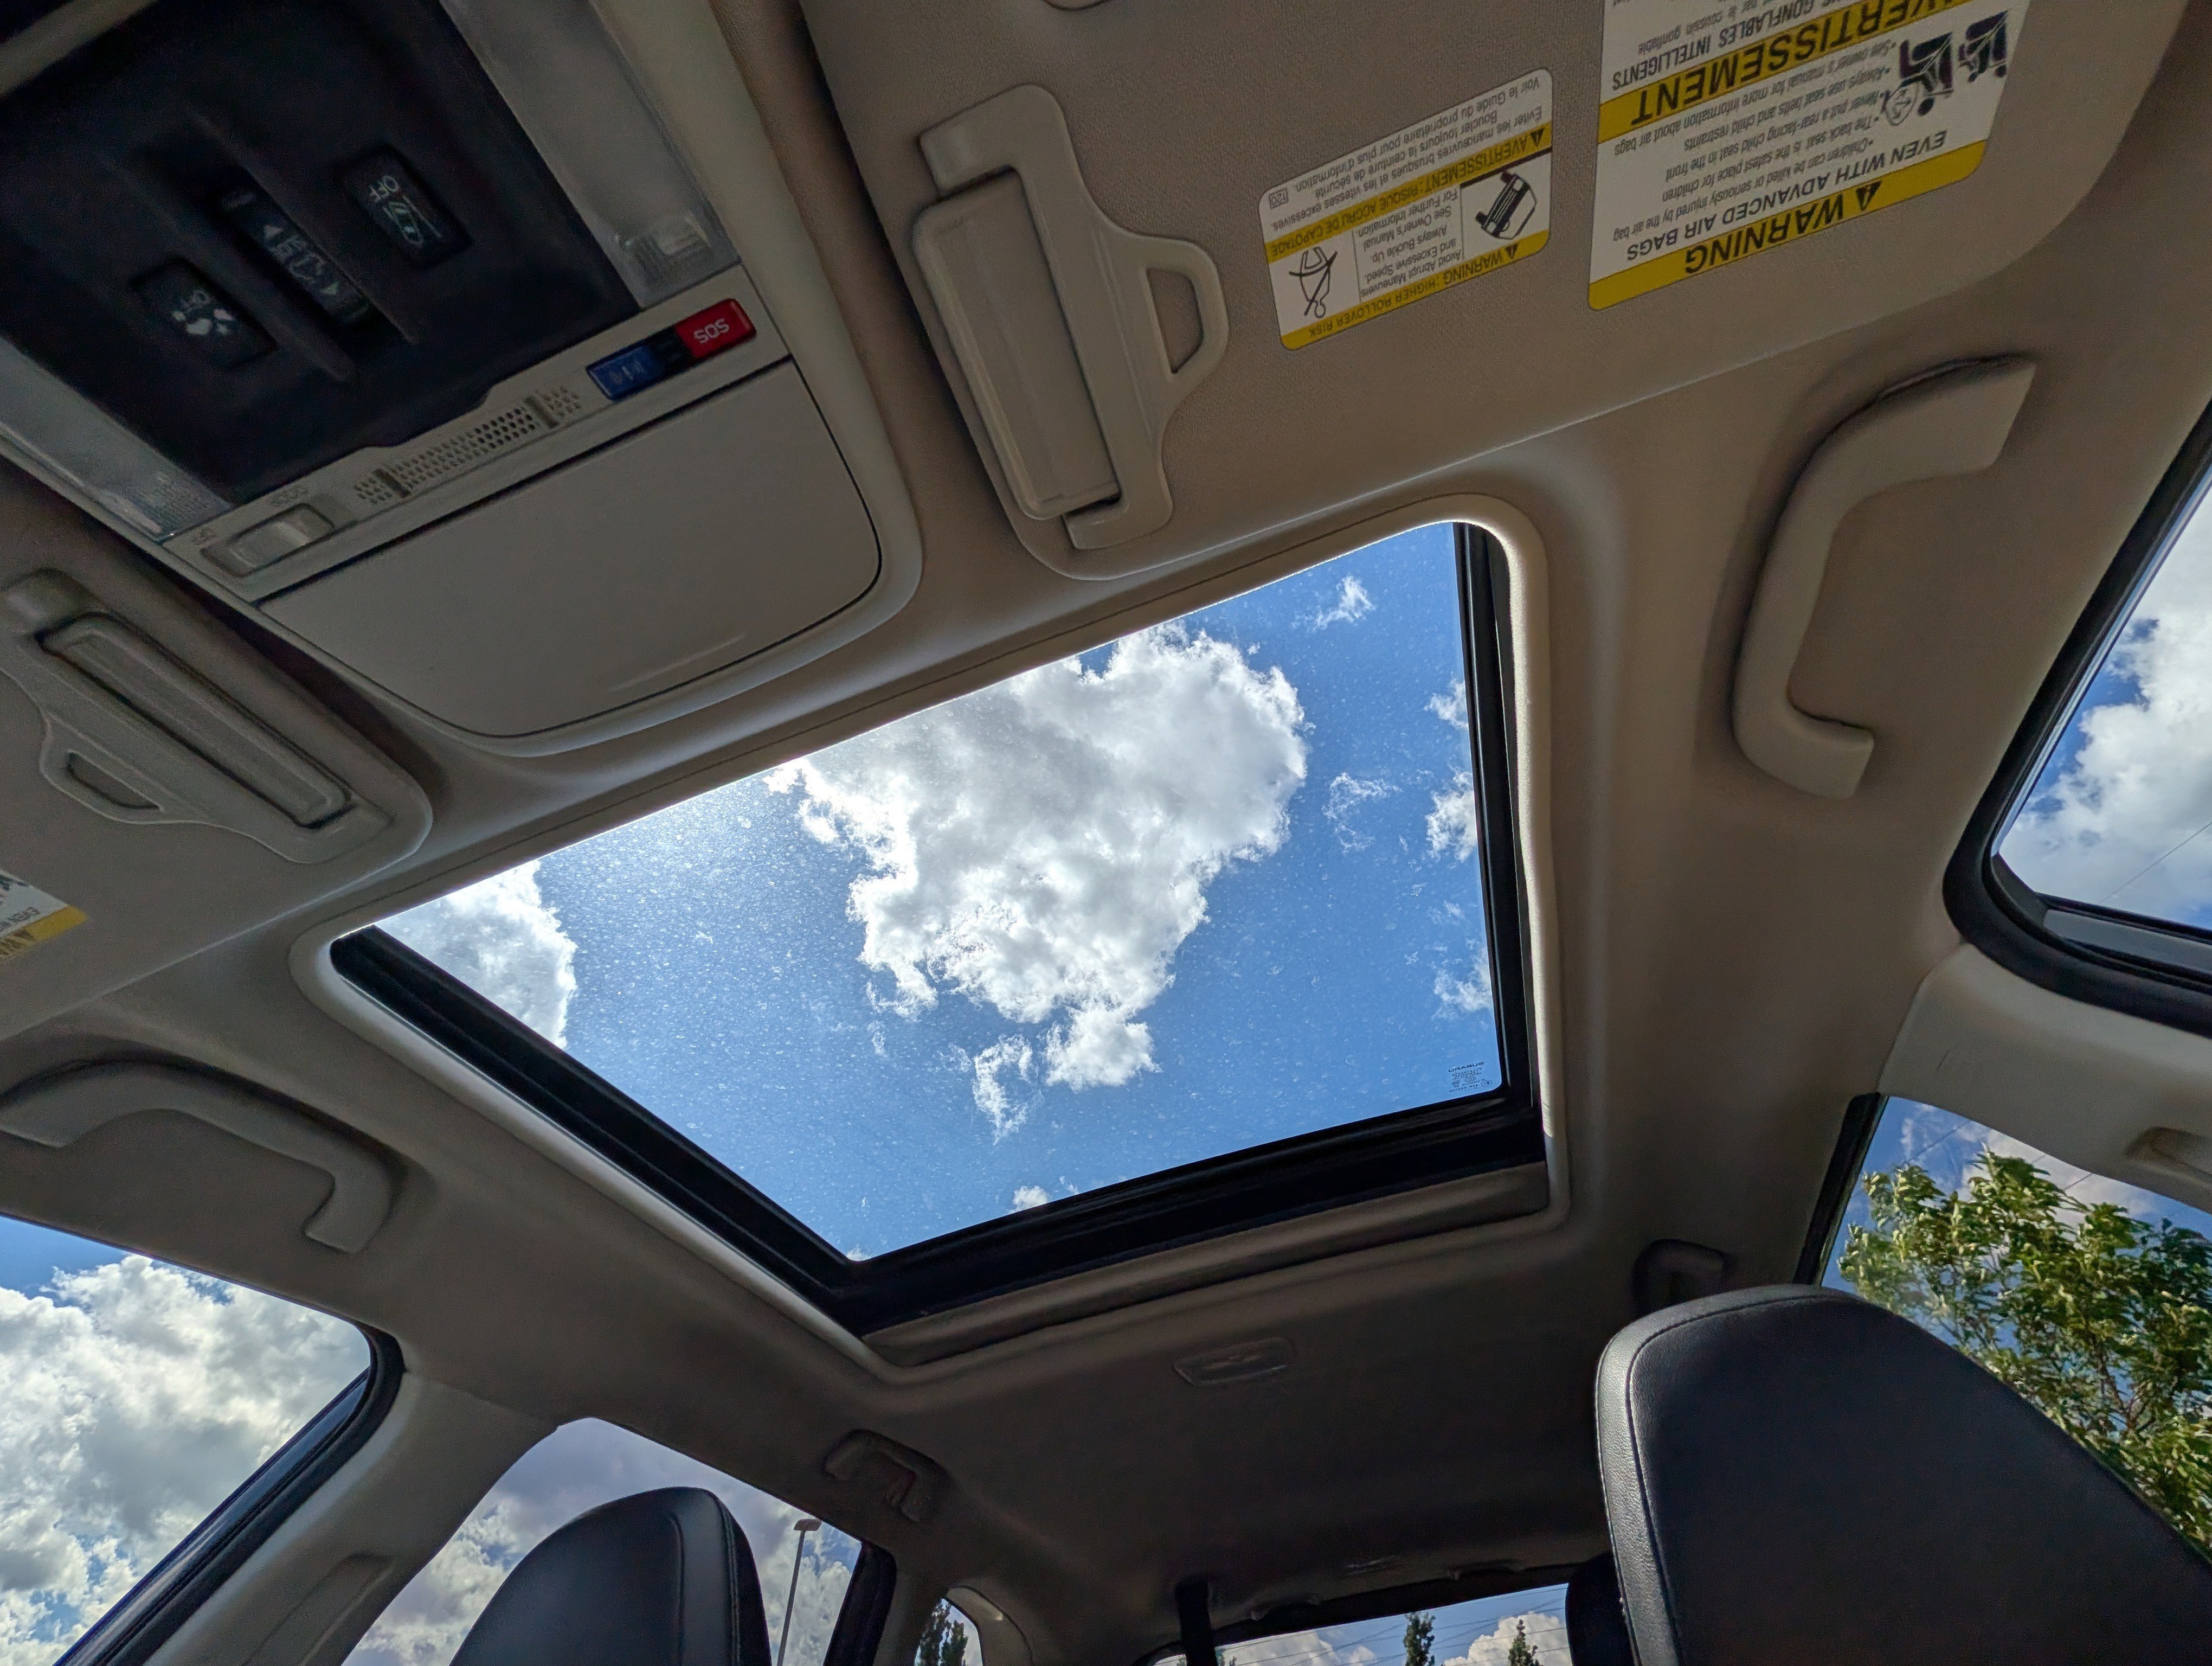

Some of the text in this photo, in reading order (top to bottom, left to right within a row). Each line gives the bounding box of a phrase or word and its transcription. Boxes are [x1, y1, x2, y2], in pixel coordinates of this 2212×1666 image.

[1612, 35, 1711, 91] INTELLIGENTS
[1631, 0, 1950, 125] ERTISSEMENT
[1508, 85, 1517, 102] le
[1520, 75, 1539, 97] Voir
[1741, 86, 1768, 106] more
[1461, 105, 1473, 122] du
[1476, 91, 1505, 116] Guide
[1682, 97, 1740, 131] information
[1461, 110, 1496, 138] Boucler
[1731, 114, 1755, 136] child
[1757, 106, 1777, 125] and
[1403, 108, 1458, 147] propriétaire
[1497, 119, 1510, 137] les
[1653, 120, 1681, 144] about
[1683, 124, 1729, 153] restraints
[1379, 134, 1400, 156] pour
[1419, 125, 1457, 154] toujours
[1613, 134, 1637, 158] bags
[1638, 131, 1651, 149] air
[1741, 132, 1765, 154] child
[1356, 146, 1377, 167] plus
[1408, 145, 1417, 159] la
[1707, 151, 1717, 166] in
[1719, 142, 1739, 161] seat
[1774, 144, 1791, 164] the
[1807, 152, 1826, 169] can
[1367, 150, 1405, 177] ceinture
[1391, 151, 1433, 182] brusques
[1665, 162, 1689, 183] front
[1690, 155, 1706, 172] the
[1716, 161, 1742, 185] place
[1742, 151, 1773, 175] safest
[1353, 168, 1365, 184] de
[1363, 178, 1377, 193] les
[1379, 173, 1388, 186] et
[1701, 172, 1715, 191] for
[1753, 176, 1764, 190] or
[1766, 165, 1791, 187] killed
[368, 174, 400, 203] OFF
[1270, 134, 1527, 258] AVERTISSEMENT RISQUE ACCRU DE CAPOTAGE
[1324, 185, 1361, 210] vitesses
[1442, 188, 1457, 205] For
[1626, 129, 1948, 262] EVEN WITH ADVANCED AIR BAGS
[1661, 178, 1700, 206] children
[1709, 177, 1752, 208] seriously
[1409, 195, 1439, 219] Further
[1662, 207, 1674, 226] by
[1675, 194, 1708, 221] injured
[1363, 204, 1451, 252] See Owner's Manual
[1417, 222, 1447, 247] Always
[1612, 224, 1630, 246] bag
[1631, 221, 1643, 238] air
[1645, 215, 1660, 233] the
[1683, 191, 1848, 276] WARNING
[1386, 238, 1414, 259] Buckle
[1440, 238, 1456, 254] and
[1396, 246, 1437, 272] Excessive
[1360, 248, 1461, 300] Avoid Abrupt Maneuvers
[1308, 249, 1501, 338] WARNING HIGHER ROLLOVER RISK
[693, 317, 730, 344] SOS
